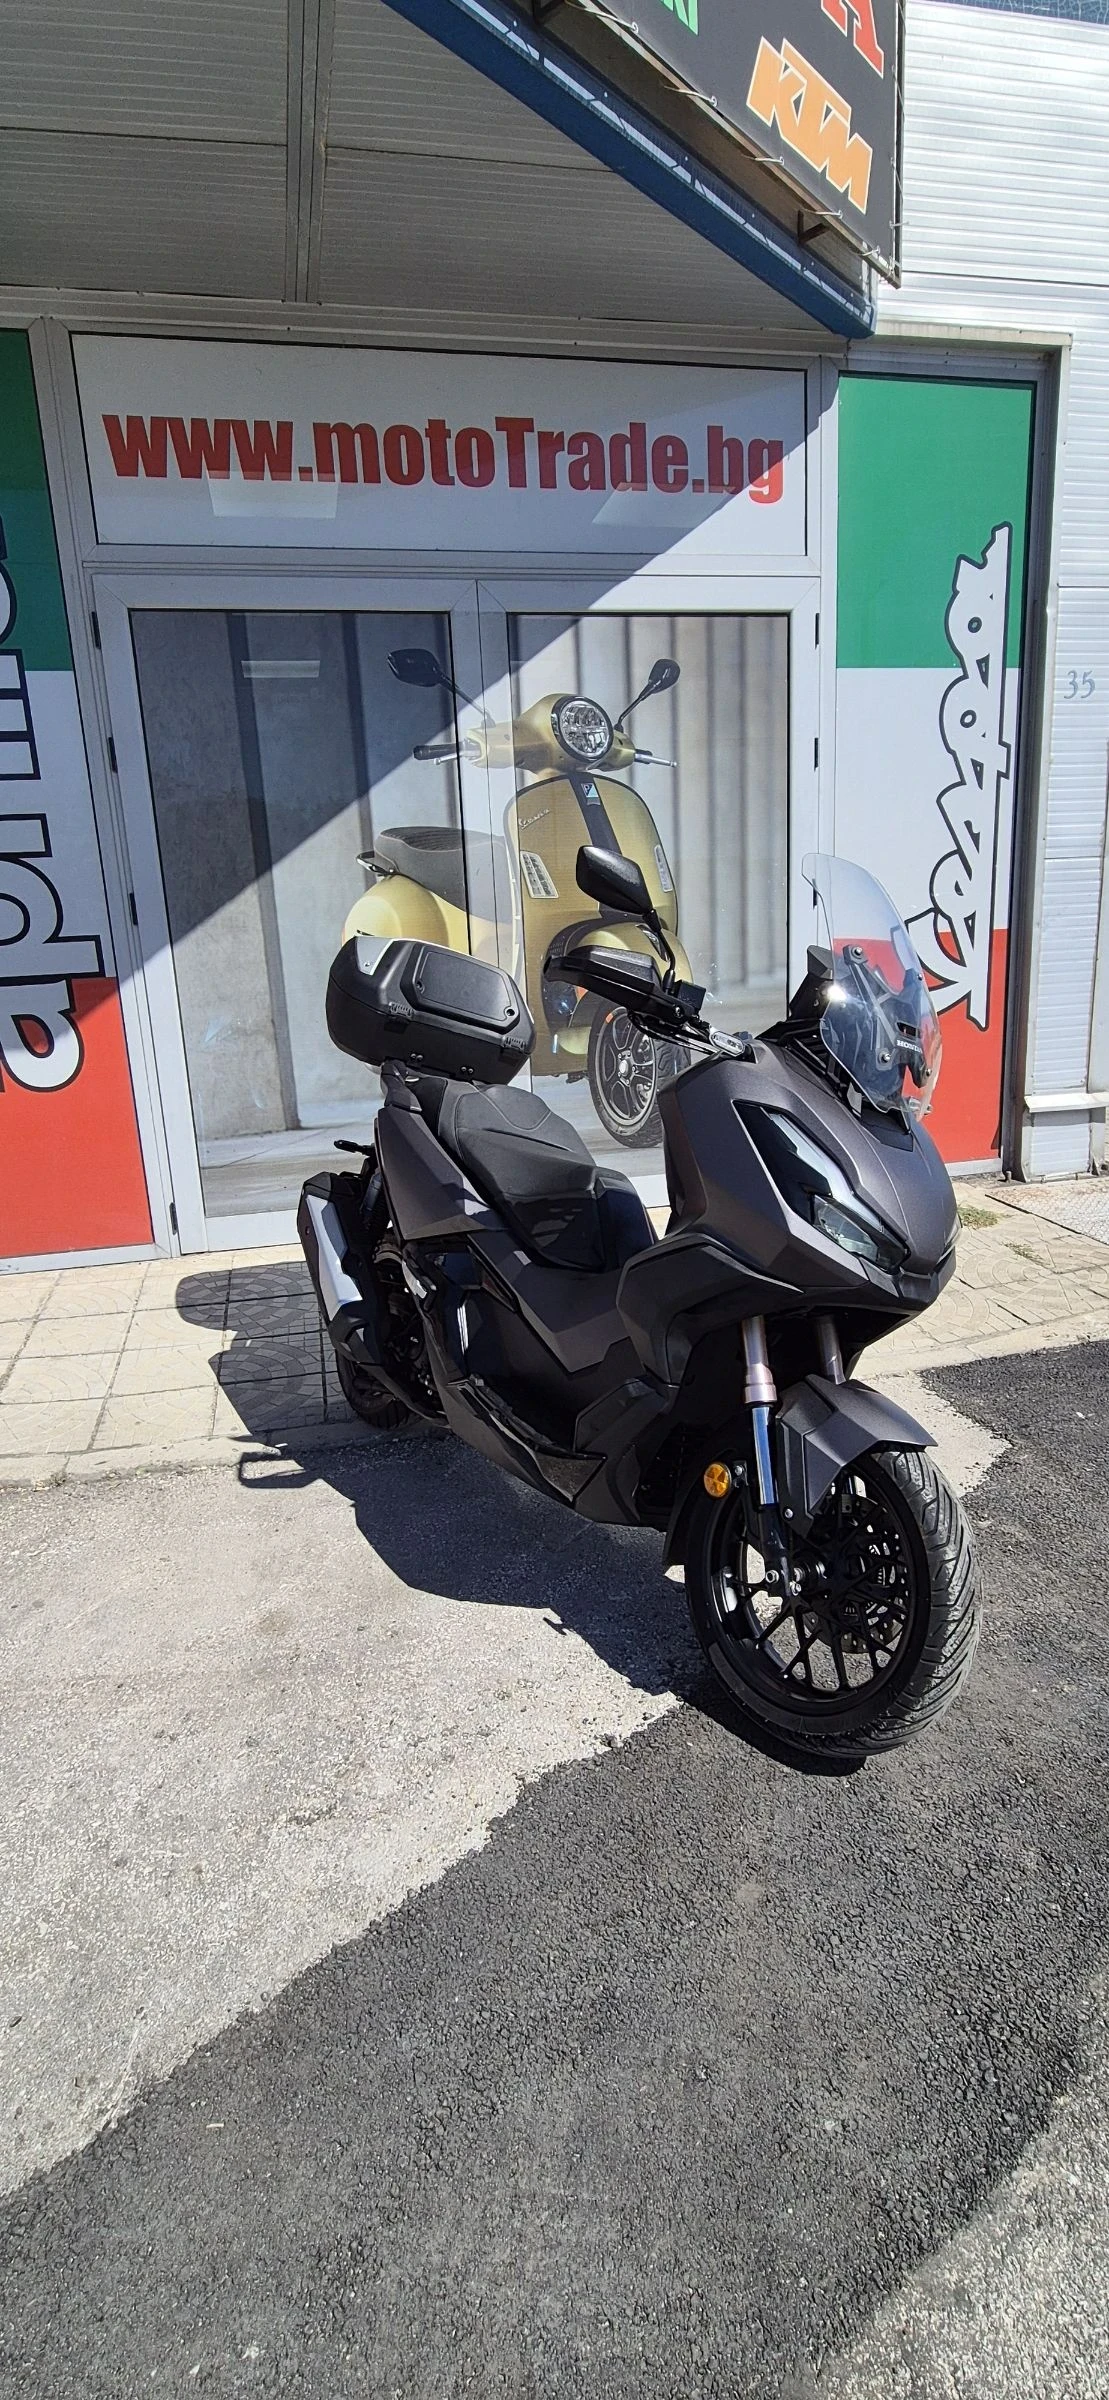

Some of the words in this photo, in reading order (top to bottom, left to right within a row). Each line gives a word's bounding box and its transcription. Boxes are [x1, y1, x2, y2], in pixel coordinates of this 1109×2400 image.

[746, 36, 872, 214] KTM
[101, 414, 783, 504] www.motoTrade.bg
[1064, 670, 1096, 699] 35
[897, 521, 1012, 1031] Vespa
